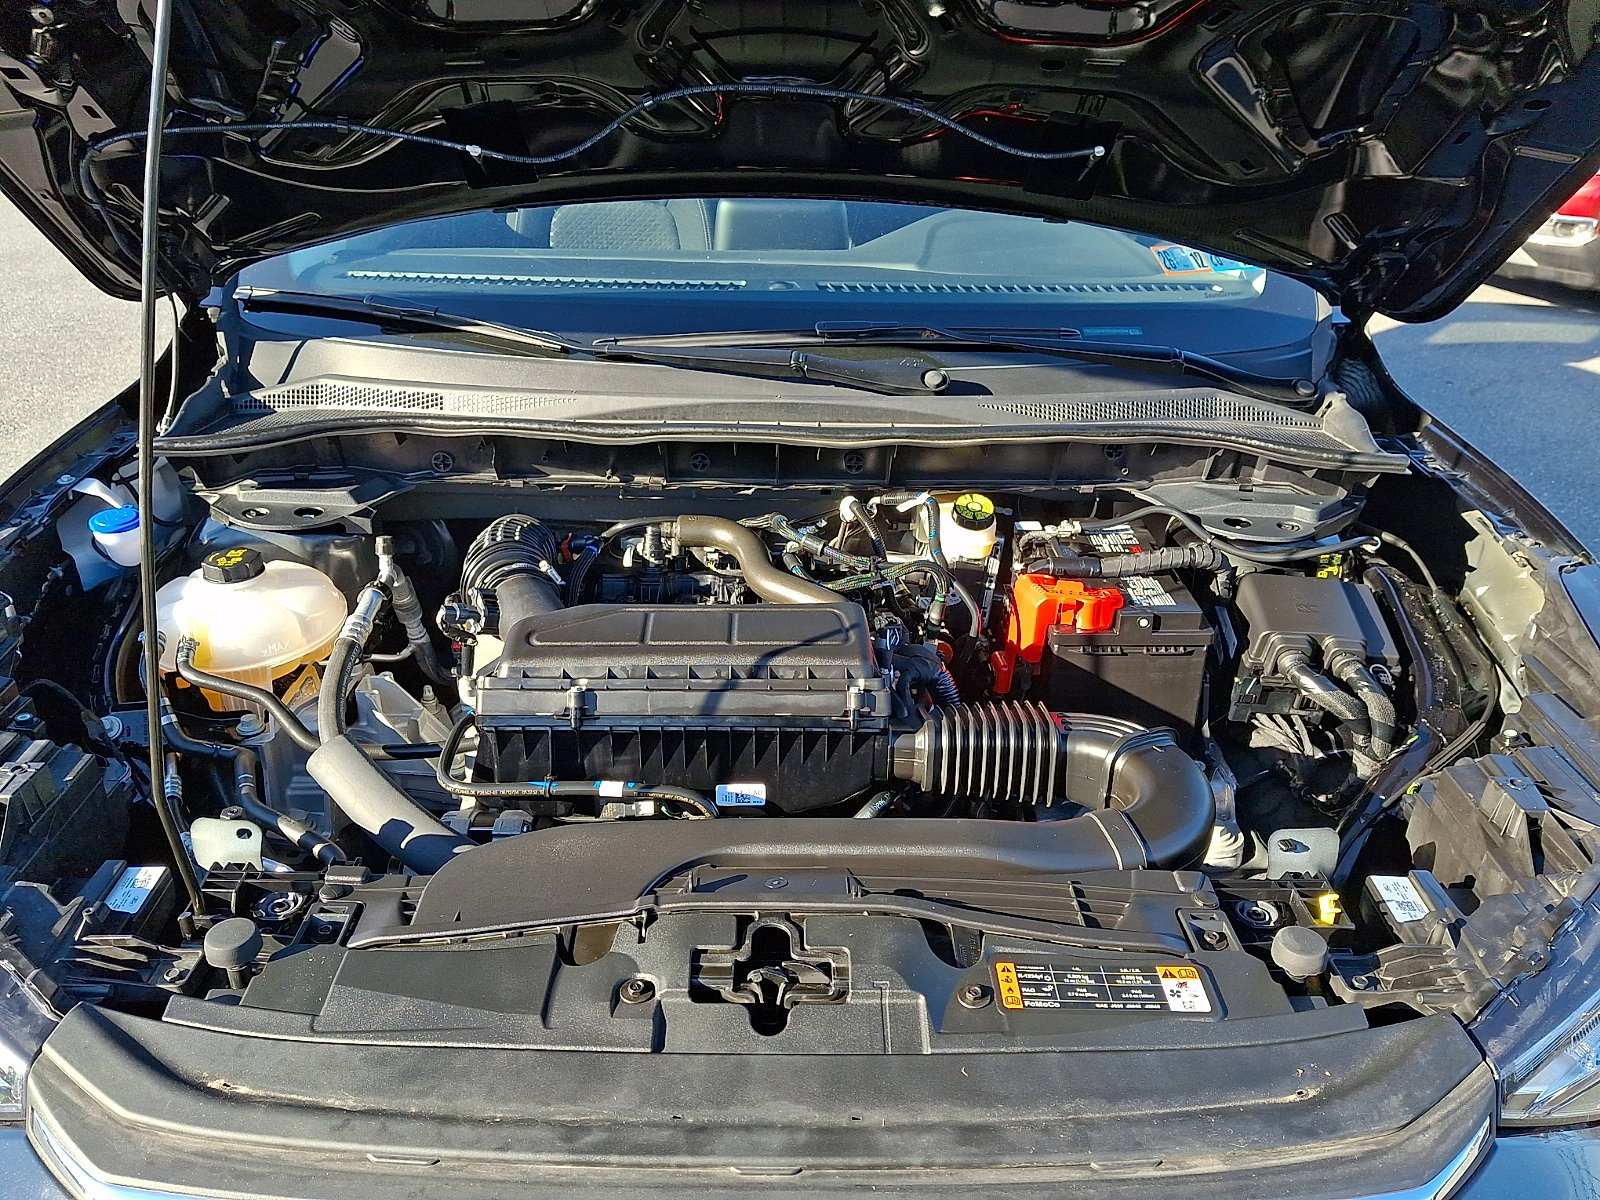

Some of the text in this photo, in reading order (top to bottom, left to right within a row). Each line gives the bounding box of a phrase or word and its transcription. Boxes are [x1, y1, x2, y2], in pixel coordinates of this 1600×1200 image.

[1156, 250, 1209, 270] 26 12
[267, 639, 292, 654] MAX
[1024, 1000, 1061, 1008] FoMoCo
